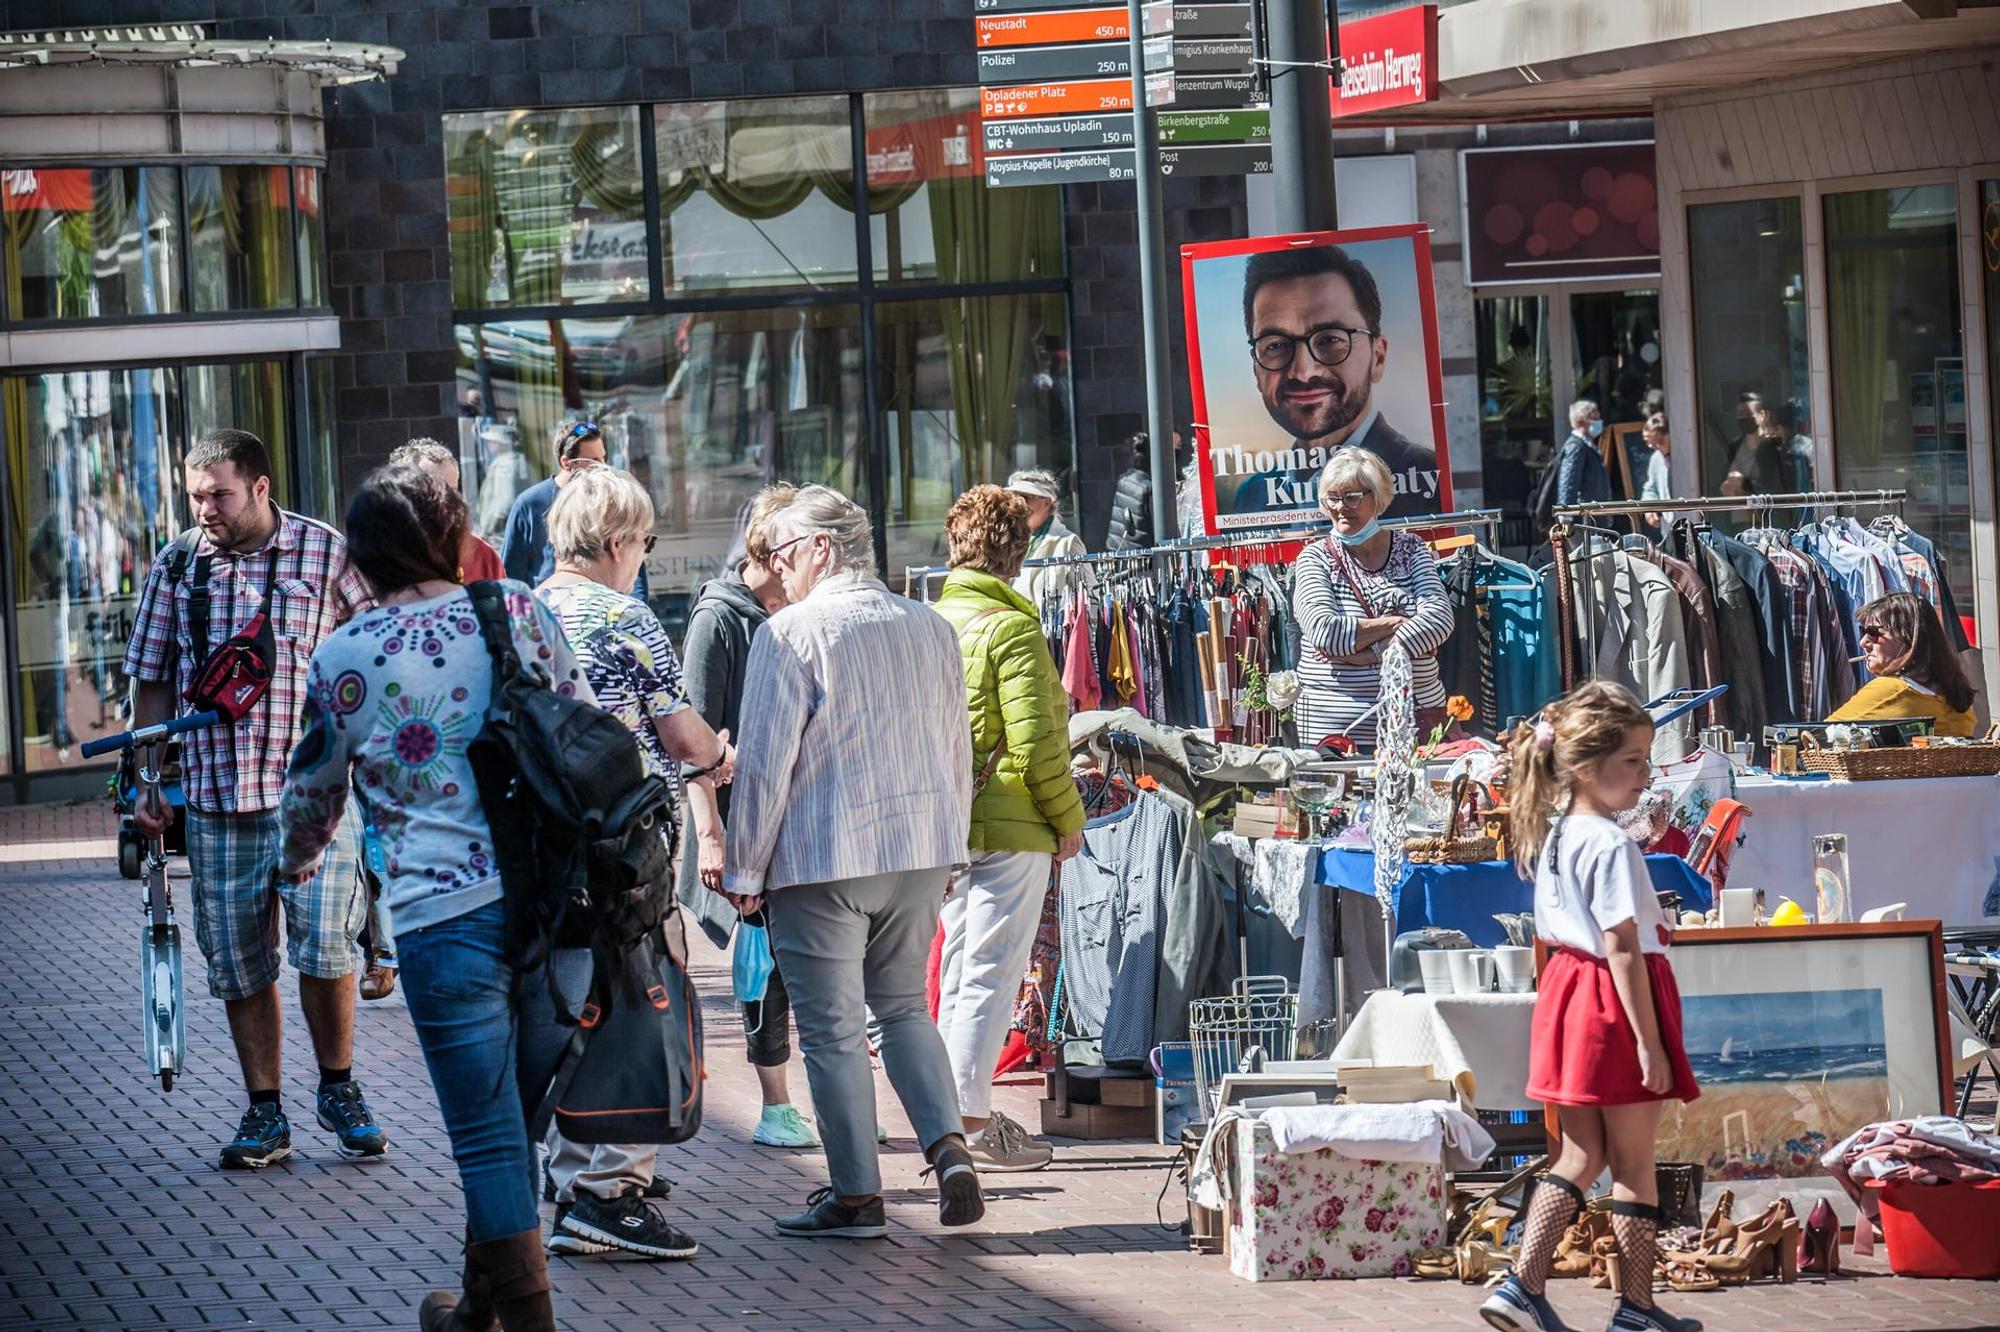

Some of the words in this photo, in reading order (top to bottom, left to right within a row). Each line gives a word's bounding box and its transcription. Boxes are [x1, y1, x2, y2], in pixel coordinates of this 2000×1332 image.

[980, 19, 1027, 30] Neustadt
[1096, 26, 1114, 37] 450
[1116, 26, 1126, 35] m
[1203, 44, 1252, 55] Krankenhaus
[981, 54, 1016, 66] Polizei
[1097, 61, 1116, 73] 250
[1118, 62, 1128, 71] m
[1340, 52, 1385, 98] Reisebüro
[1384, 48, 1422, 97] Herweg
[985, 88, 1039, 102] Opladener
[1041, 86, 1067, 97] Platz
[1249, 92, 1264, 102] 350
[1100, 96, 1118, 107] 250
[1120, 97, 1130, 106] m
[1158, 114, 1230, 128] Birkenbergstraße
[986, 123, 1061, 137] CBT-Wohnhaus
[1063, 120, 1102, 134] Upladin
[1251, 127, 1266, 137] 250
[1102, 132, 1119, 143] 150
[1122, 132, 1132, 141] m
[987, 138, 1004, 149] WC
[1160, 152, 1179, 162] Post
[989, 158, 1052, 174] Aloysius-Kapelle
[1053, 155, 1111, 170] (Jugendkirche)
[1253, 161, 1268, 172] 200
[1109, 167, 1122, 178] 80
[1124, 168, 1134, 177] m
[1223, 512, 1307, 526] Ministerpräsident
[1310, 511, 1326, 520] vo
